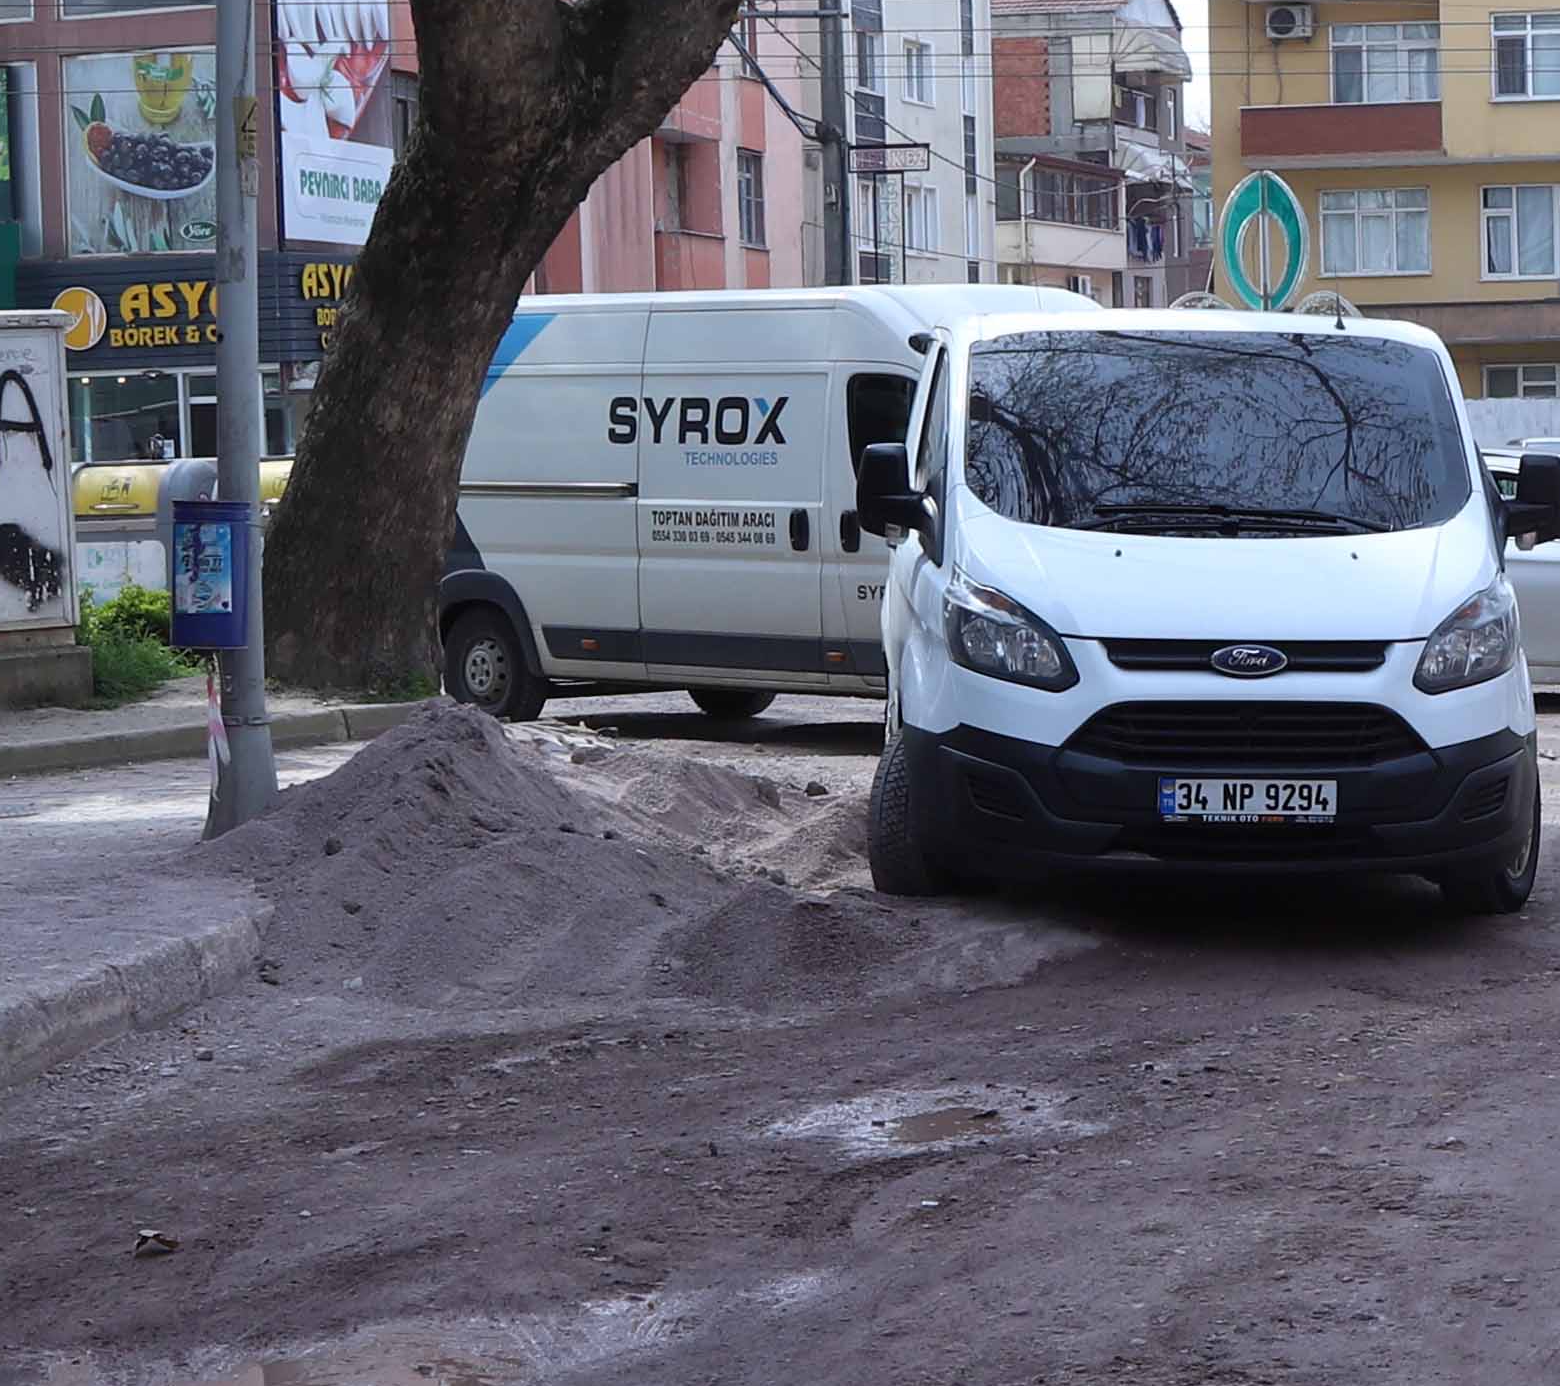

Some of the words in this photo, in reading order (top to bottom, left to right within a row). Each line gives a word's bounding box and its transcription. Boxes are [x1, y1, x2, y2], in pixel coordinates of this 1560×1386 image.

[119, 281, 217, 324] ASY
[110, 322, 179, 348] BÖREK
[187, 329, 201, 345] &
[608, 396, 790, 445] SYROX
[685, 452, 778, 465] TECHNOLOGIES
[651, 510, 692, 526] TOPTAN
[695, 509, 739, 527] DAĞITIM
[742, 512, 775, 528] ARACI
[1177, 782, 1209, 811] 34
[1222, 782, 1254, 812] NP
[1265, 783, 1330, 812] 9294
